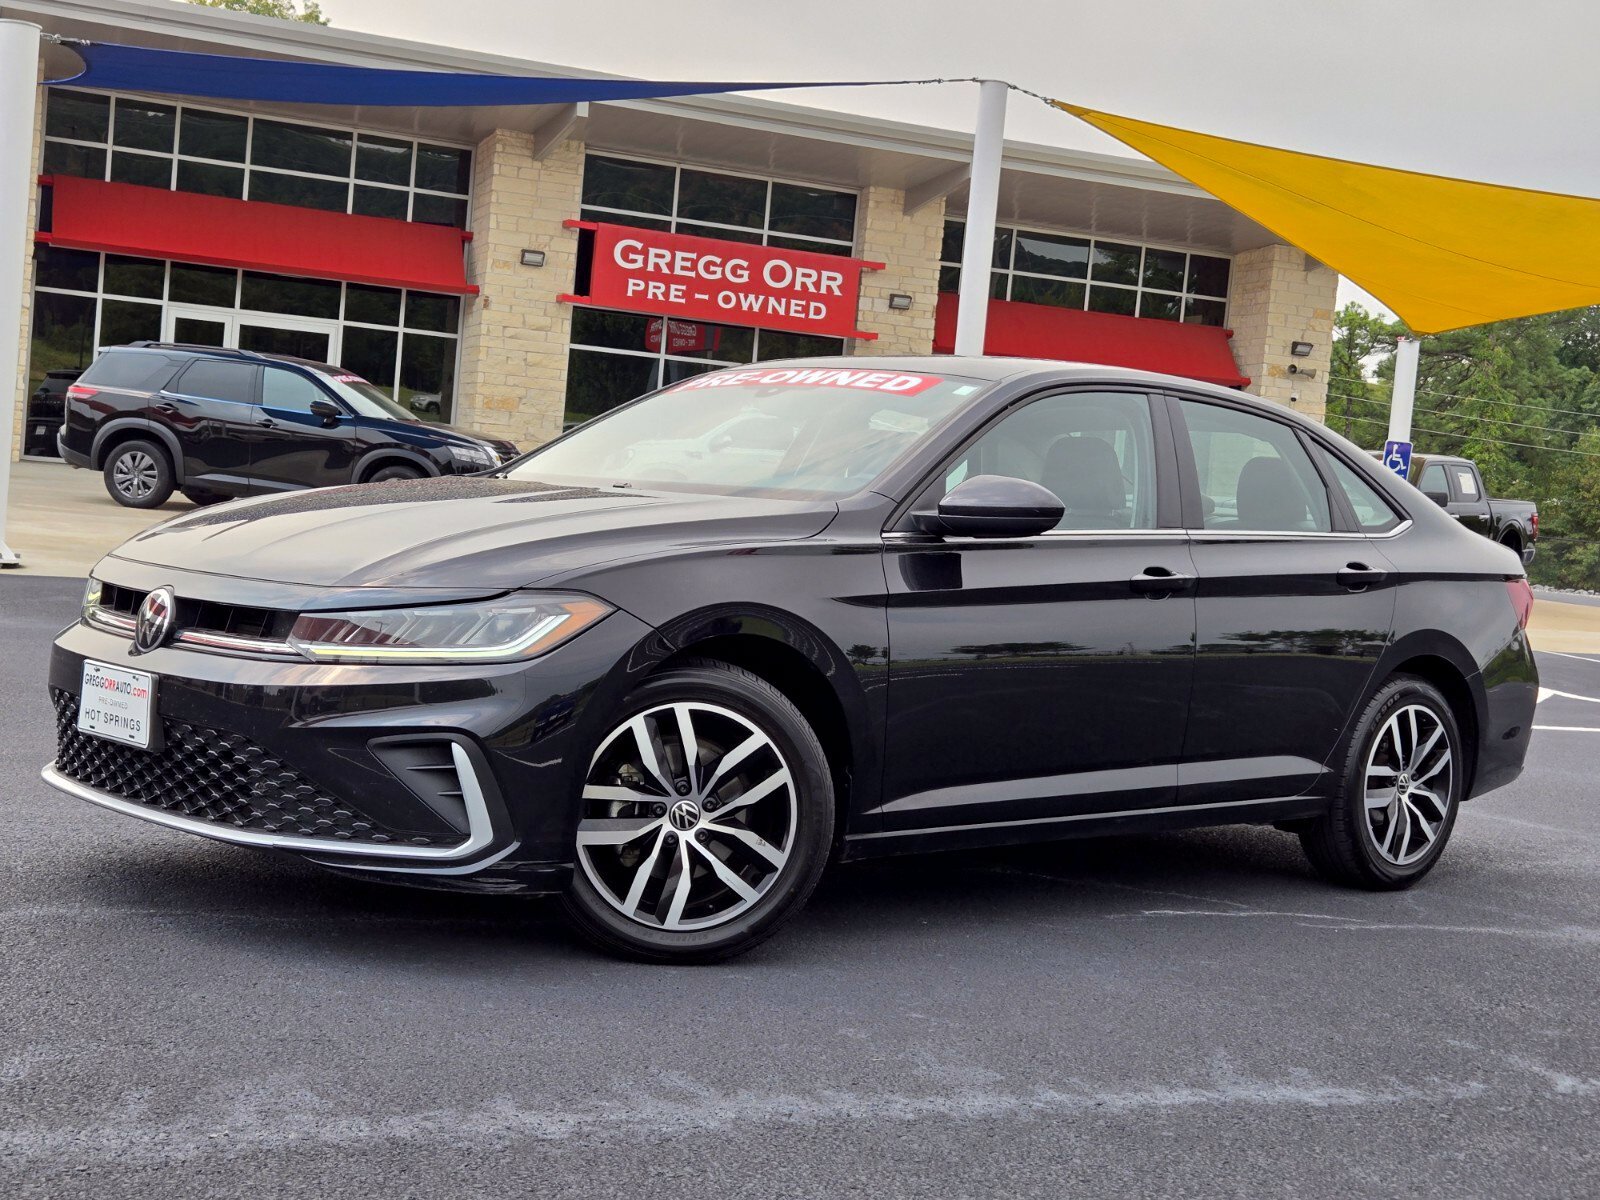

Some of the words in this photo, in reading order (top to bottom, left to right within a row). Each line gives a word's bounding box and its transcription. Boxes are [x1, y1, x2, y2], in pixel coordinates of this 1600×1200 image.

[613, 239, 750, 283] GREGG
[762, 259, 843, 296] ORR
[717, 290, 827, 320] OWNED
[673, 371, 922, 391] PRE-OWNED
[84, 708, 101, 722] HOT
[104, 712, 141, 732] SPRINGS
